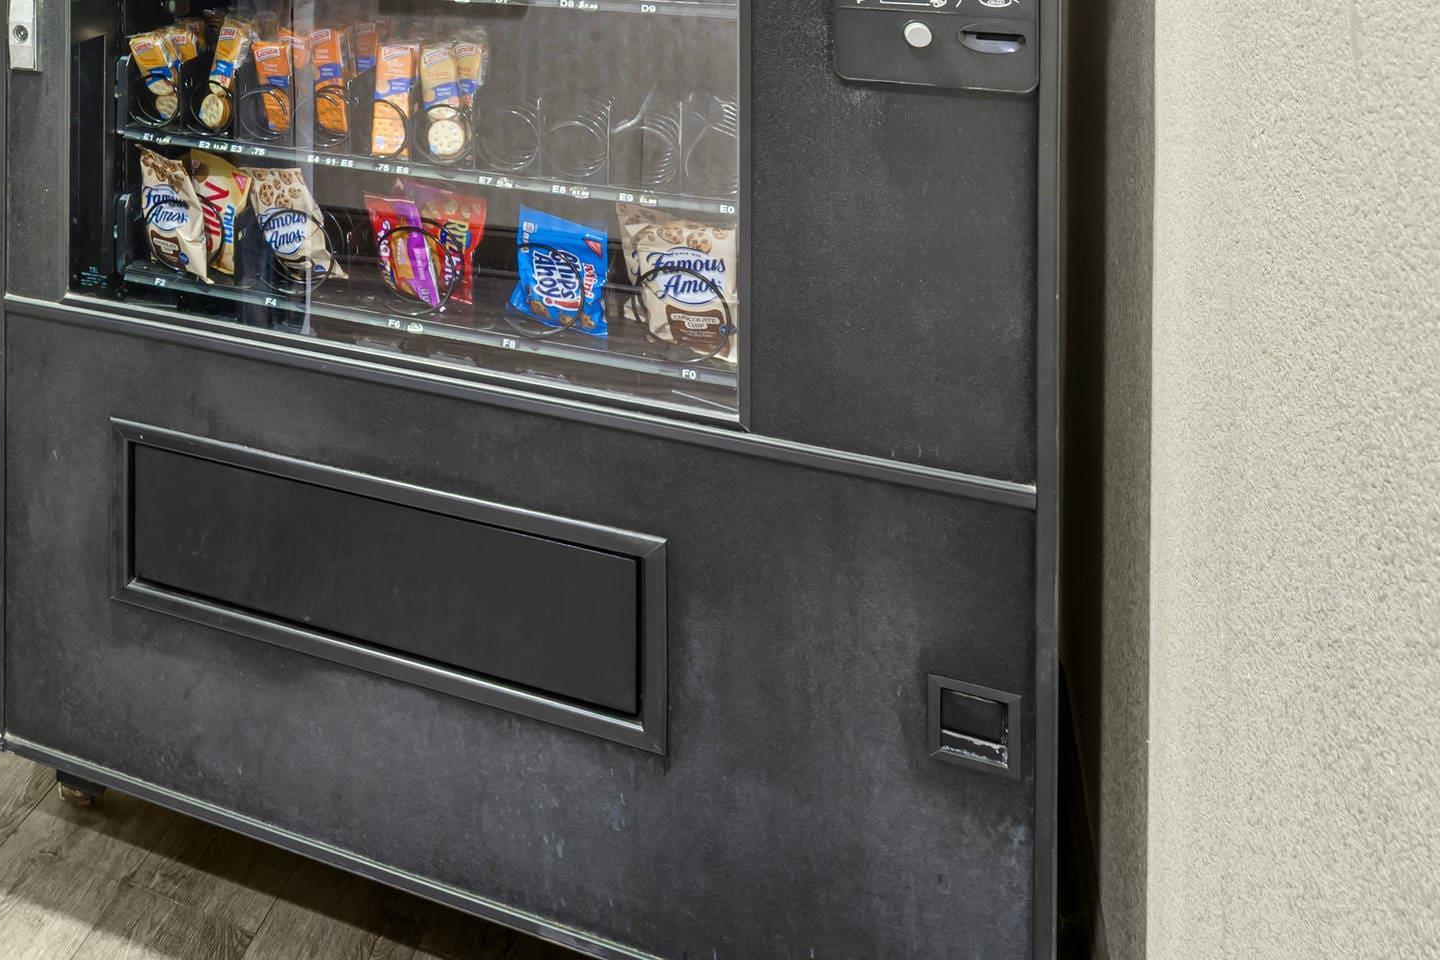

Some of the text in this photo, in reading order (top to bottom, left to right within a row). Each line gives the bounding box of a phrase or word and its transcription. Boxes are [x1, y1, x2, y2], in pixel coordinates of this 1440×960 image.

[560, 0, 575, 8] D8
[641, 4, 656, 13] D9
[199, 141, 210, 149] E2
[251, 147, 265, 155] .75
[308, 155, 320, 163] E4
[341, 159, 354, 167] E5
[396, 166, 409, 174] E6
[478, 176, 492, 184] E7
[552, 185, 566, 193] E8
[619, 193, 634, 201] E9
[720, 205, 735, 214] E0
[268, 230, 304, 250] Amos
[646, 250, 726, 282] Famous
[551, 249, 576, 300] Chips
[154, 278, 166, 287] F2
[265, 297, 277, 306] F4
[388, 319, 401, 328] F6
[502, 339, 516, 348] F8
[682, 369, 696, 379] F0
